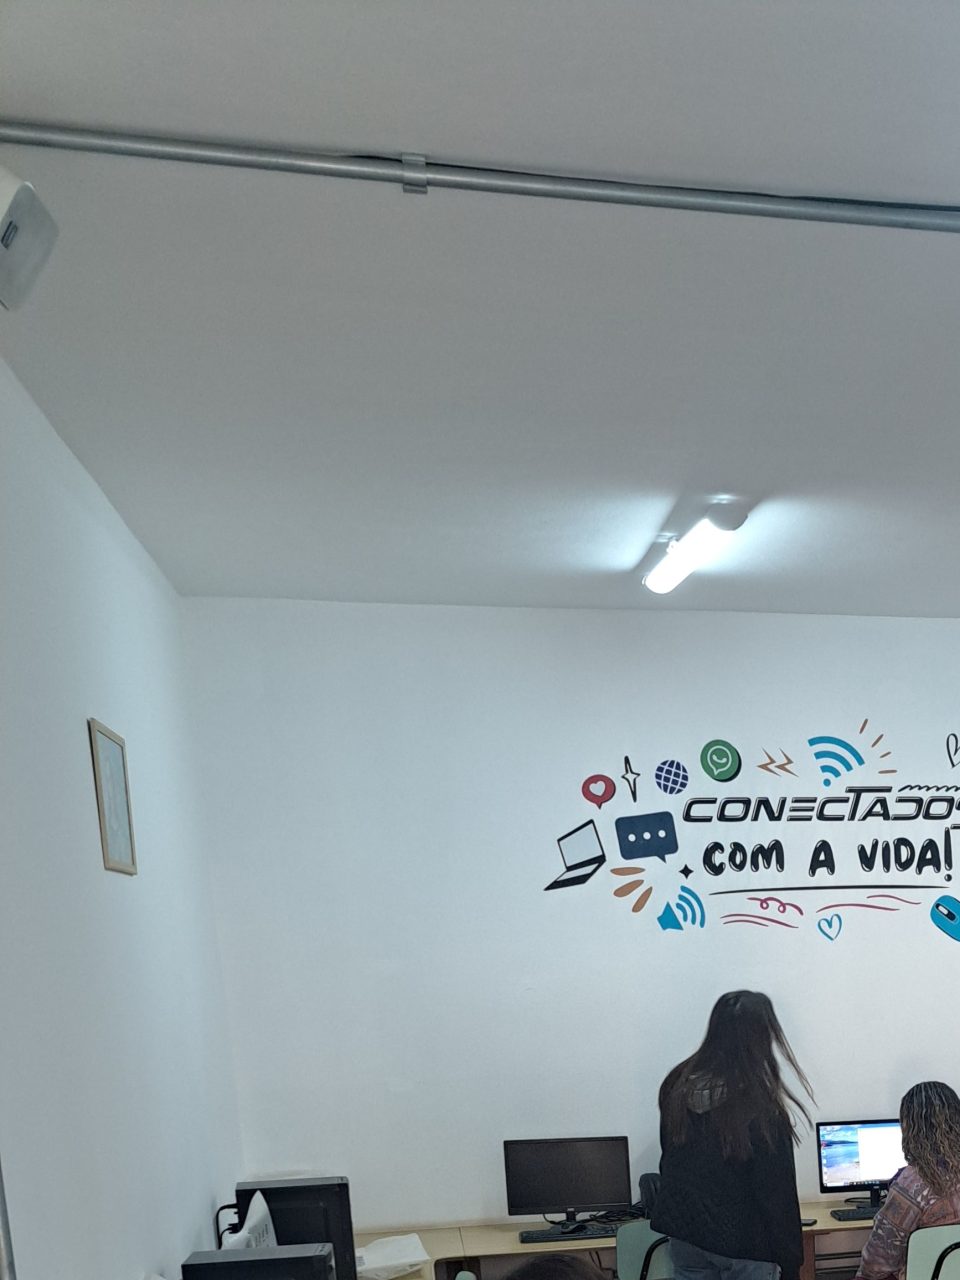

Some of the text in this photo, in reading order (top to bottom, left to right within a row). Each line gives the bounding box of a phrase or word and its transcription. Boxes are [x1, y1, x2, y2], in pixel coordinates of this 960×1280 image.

[702, 839, 785, 876] COM
[808, 839, 836, 878] A
[857, 827, 953, 882] VIDA!
